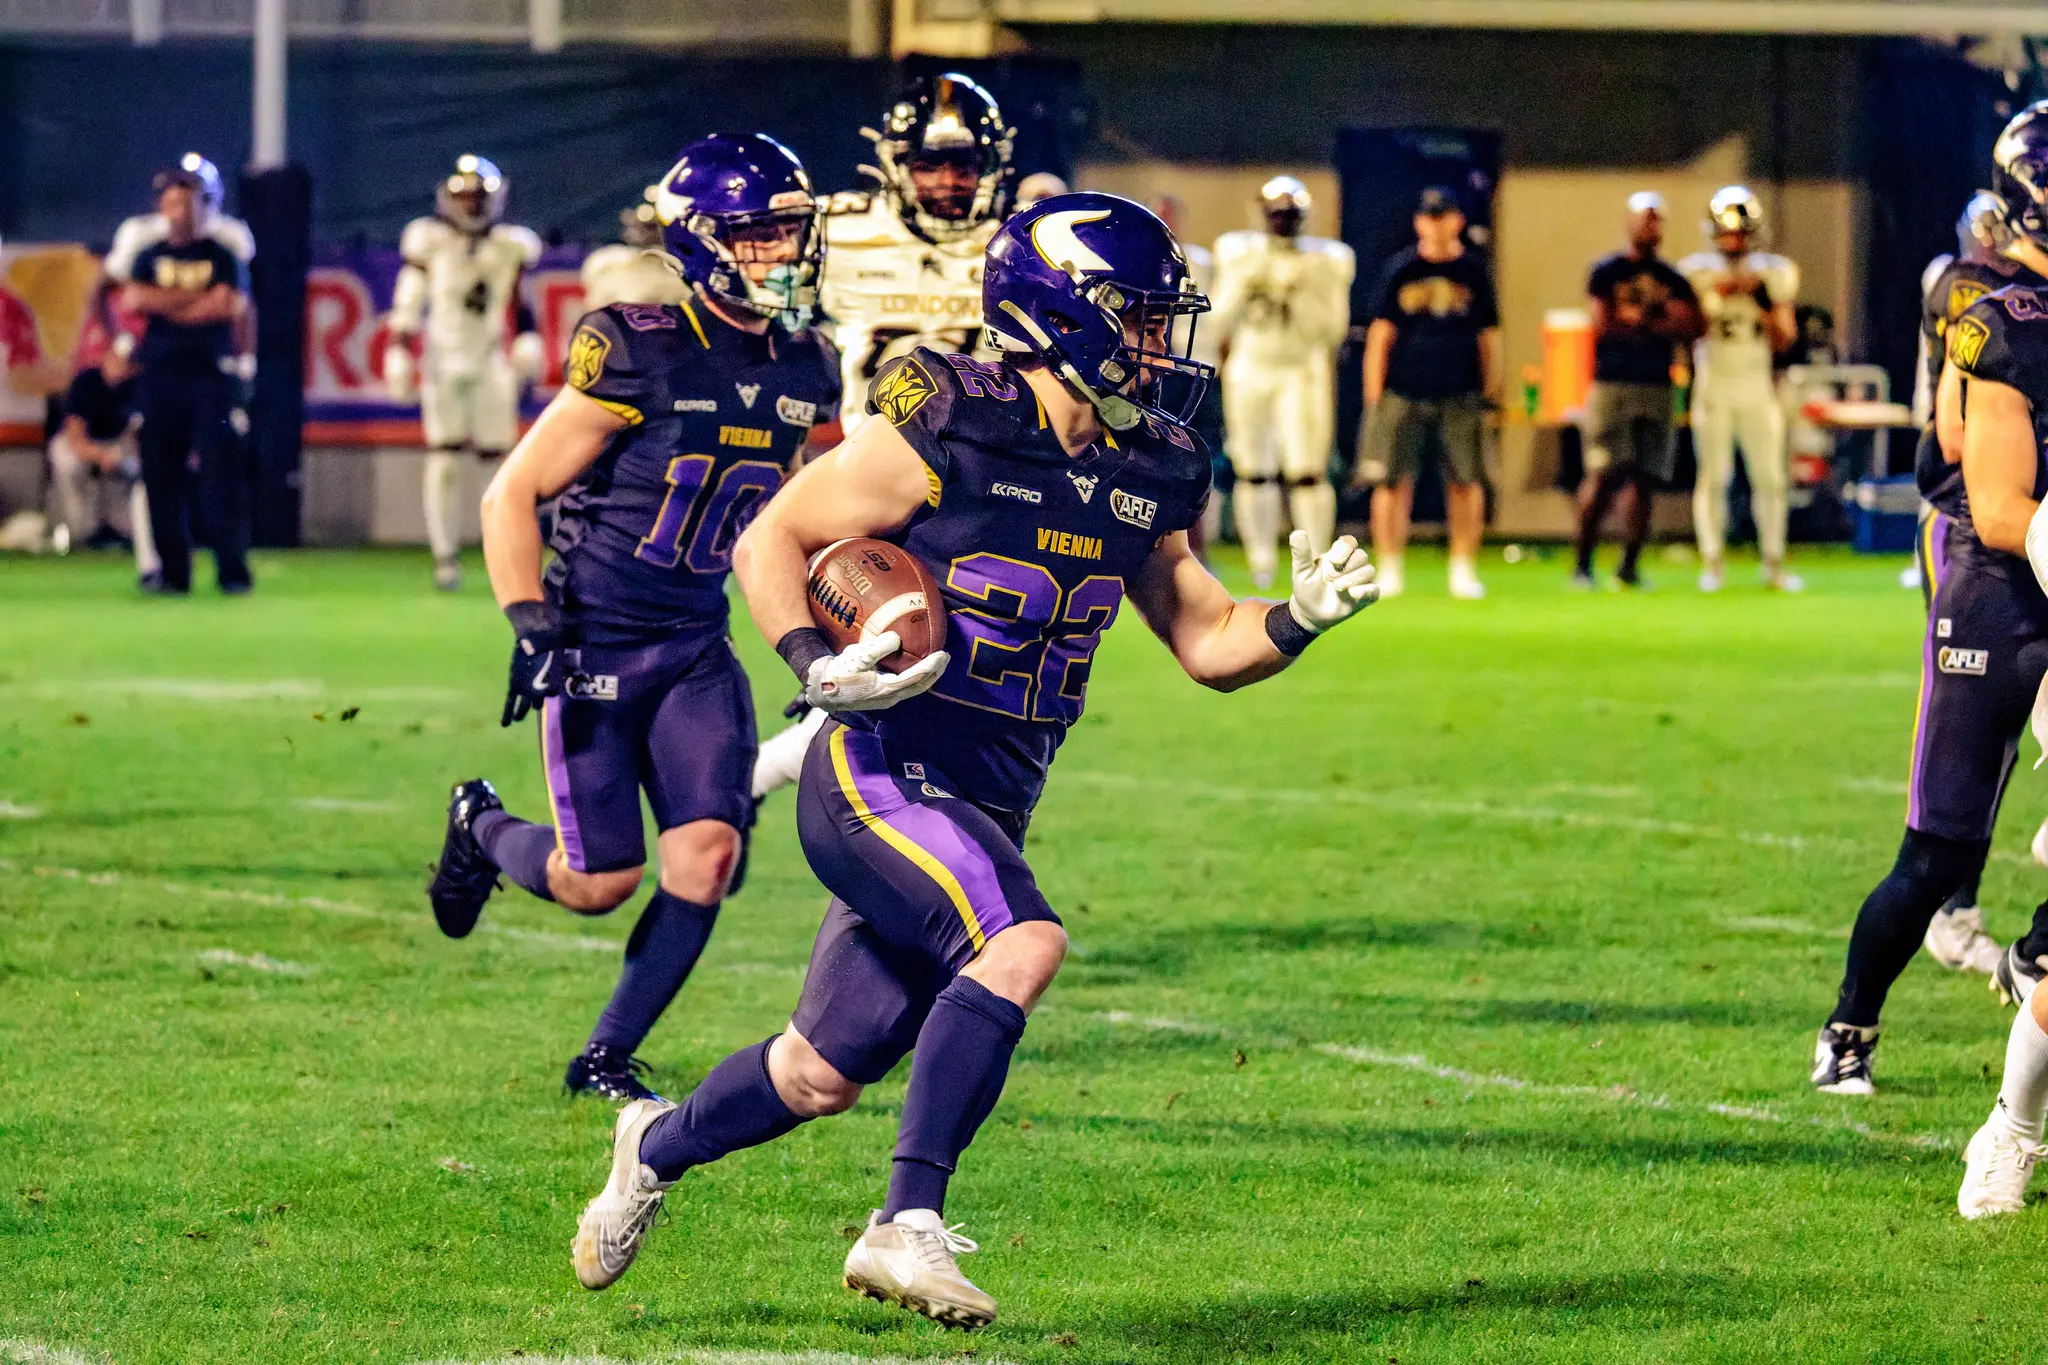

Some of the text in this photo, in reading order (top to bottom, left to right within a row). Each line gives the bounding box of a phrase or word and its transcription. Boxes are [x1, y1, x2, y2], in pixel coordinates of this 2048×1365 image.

[719, 426, 772, 448] VIENNA
[634, 453, 785, 574] 10
[1119, 496, 1155, 523] AFLE
[1037, 528, 1103, 560] VIENNA
[836, 552, 873, 597] Wilson
[929, 551, 1125, 722] 22
[1944, 651, 1985, 669] AFLE
